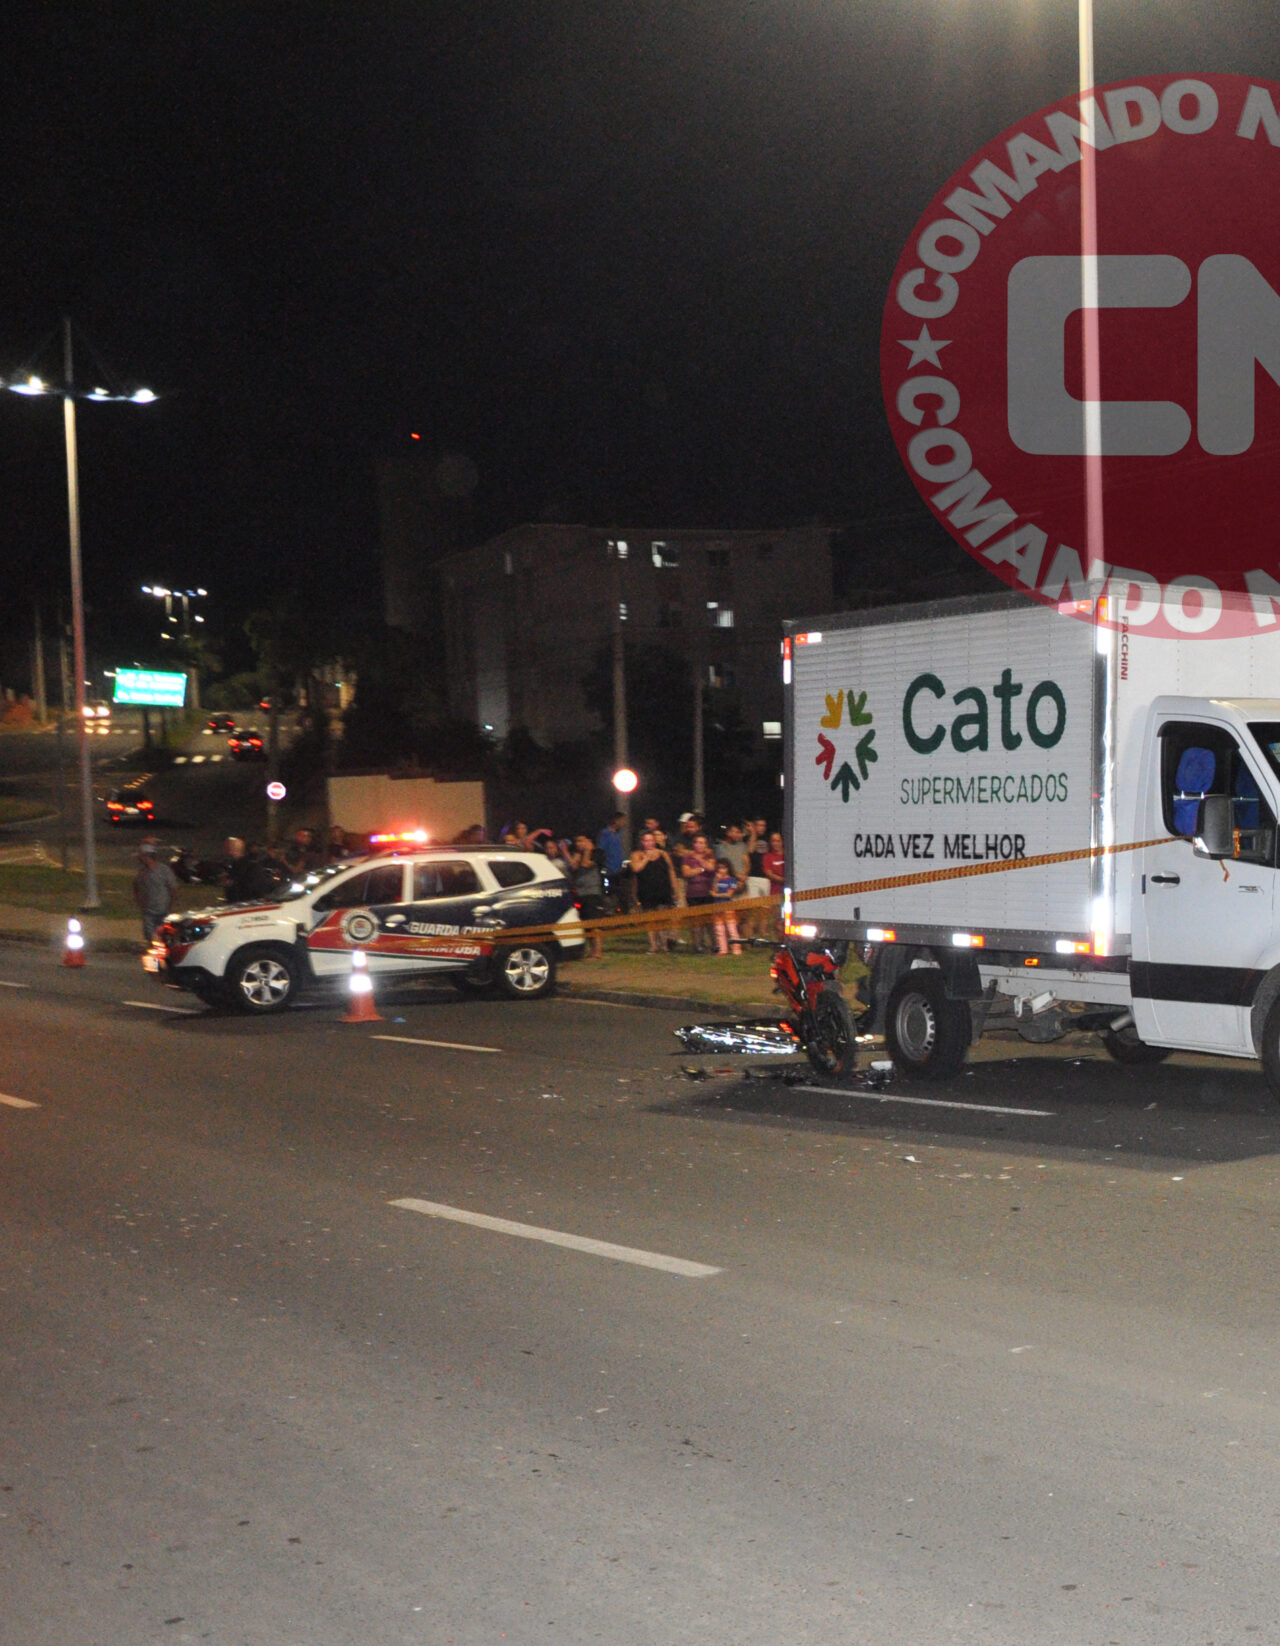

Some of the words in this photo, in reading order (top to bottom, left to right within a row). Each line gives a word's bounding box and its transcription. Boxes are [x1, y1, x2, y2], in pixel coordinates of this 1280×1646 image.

[1120, 615, 1129, 681] FACCHINI
[902, 667, 1067, 755] Cato
[900, 771, 1069, 805] SUPERMERCADOS
[853, 833, 897, 859] CADA
[899, 833, 935, 859] VEZ
[943, 833, 1026, 860] MELHOR
[409, 921, 460, 936] GUARDA
